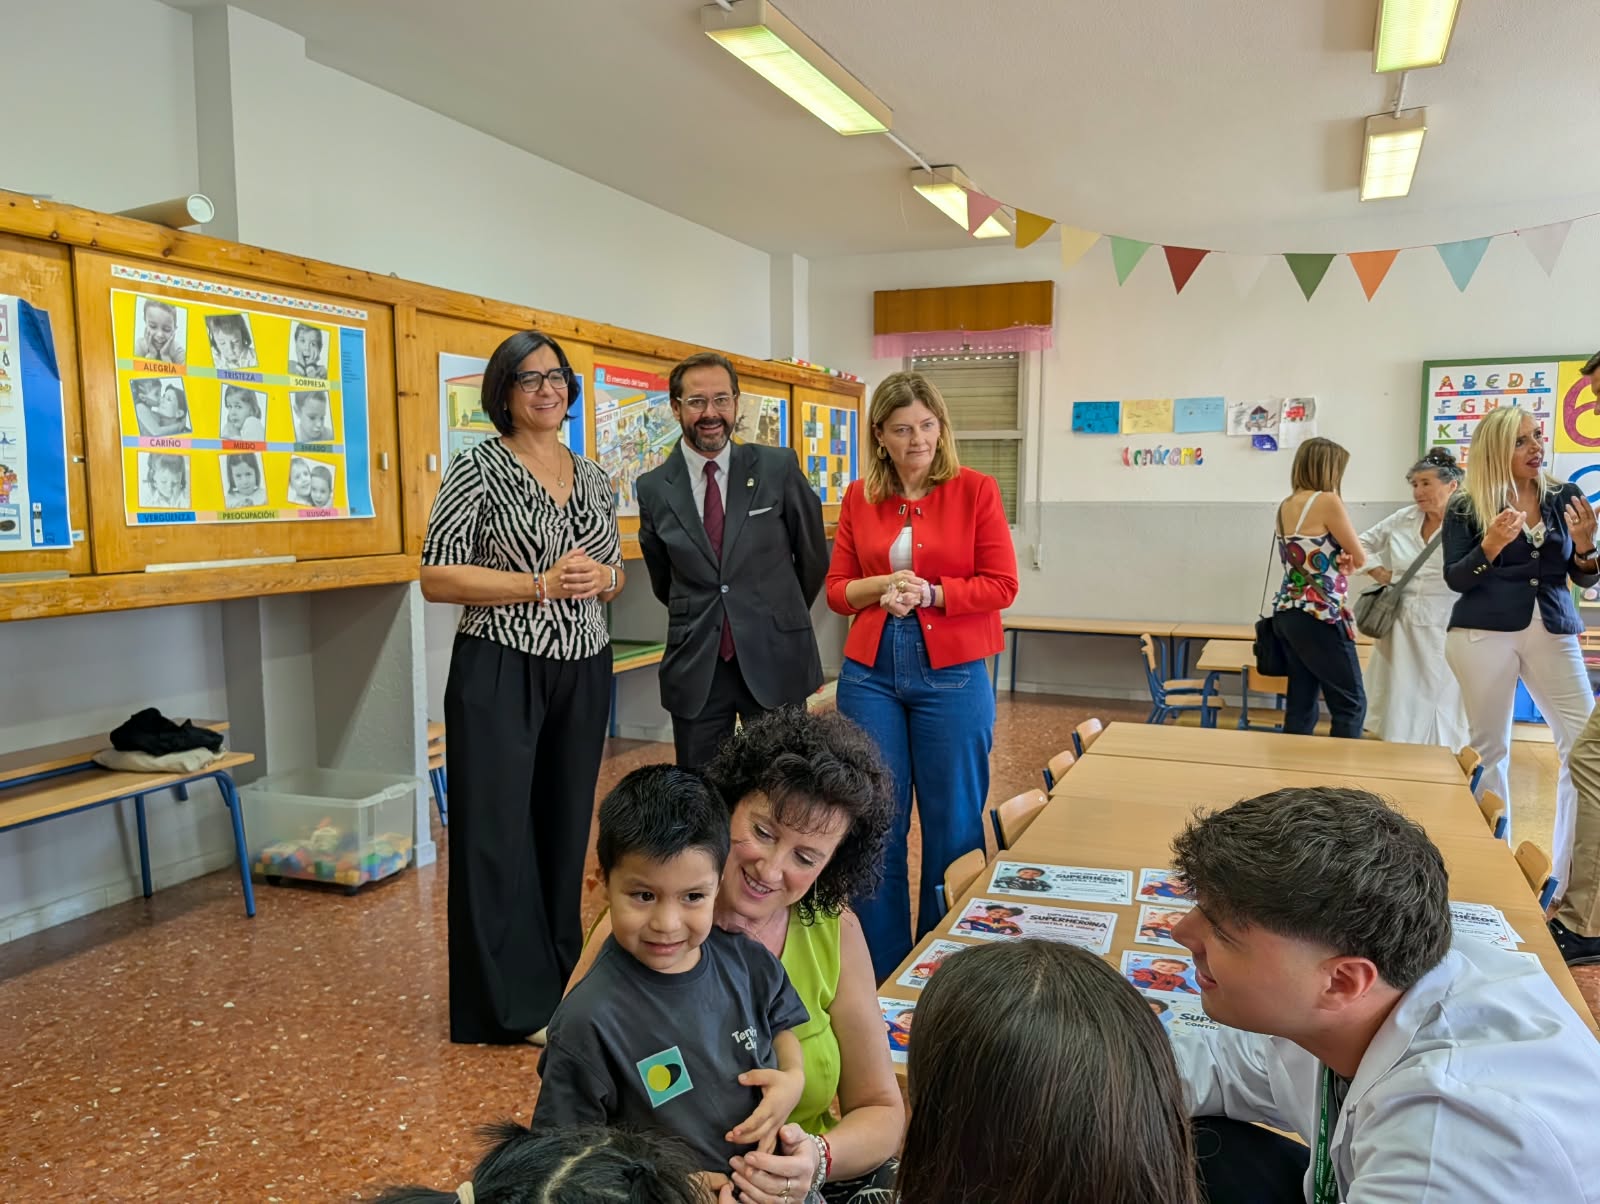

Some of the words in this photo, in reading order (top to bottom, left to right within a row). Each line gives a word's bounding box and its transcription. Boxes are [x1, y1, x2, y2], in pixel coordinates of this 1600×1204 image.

[143, 361, 177, 375] ALEGRÍA
[224, 370, 256, 382] TRISTEZA
[1439, 375, 1454, 390] A
[1463, 374, 1476, 389] B
[1486, 374, 1500, 389] C
[1508, 372, 1523, 387] D
[1534, 371, 1545, 387] E
[295, 377, 326, 389] SORPRESA
[1441, 399, 1451, 414] F
[1460, 398, 1475, 413] G
[1438, 423, 1451, 438] K
[149, 436, 181, 448] CARIÑO
[233, 440, 256, 450] MIEDO
[143, 511, 192, 523] VERGÜENZA
[222, 509, 275, 520] PREOCUPACIÓN
